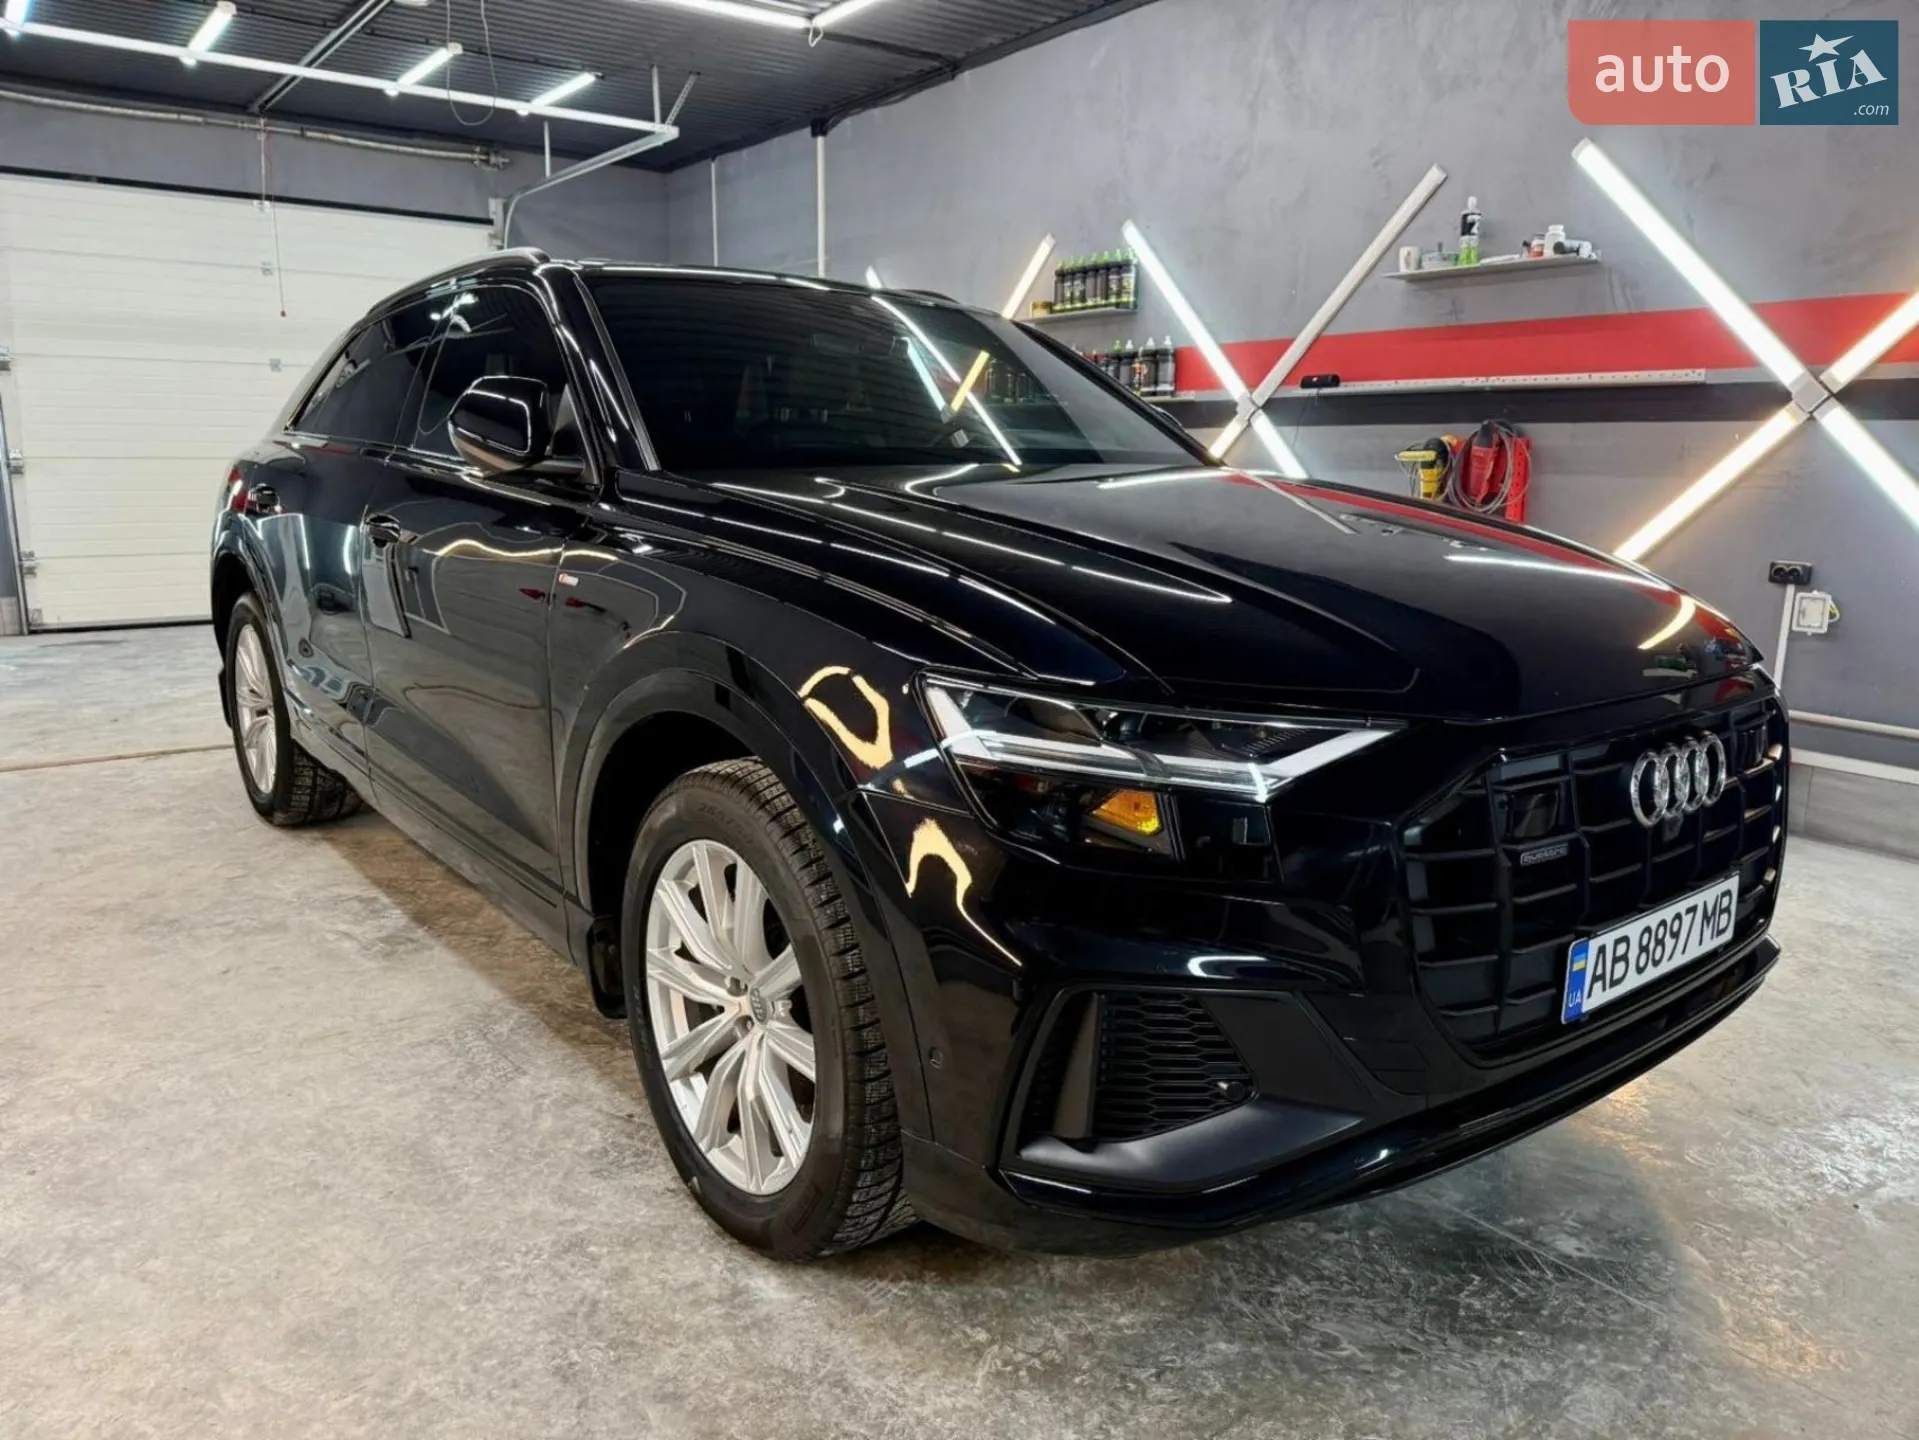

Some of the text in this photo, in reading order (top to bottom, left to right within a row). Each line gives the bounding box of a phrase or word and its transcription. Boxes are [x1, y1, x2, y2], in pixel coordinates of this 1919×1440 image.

[1587, 888, 1733, 999] AB 8897 MB
[1568, 991, 1582, 1008] UA
